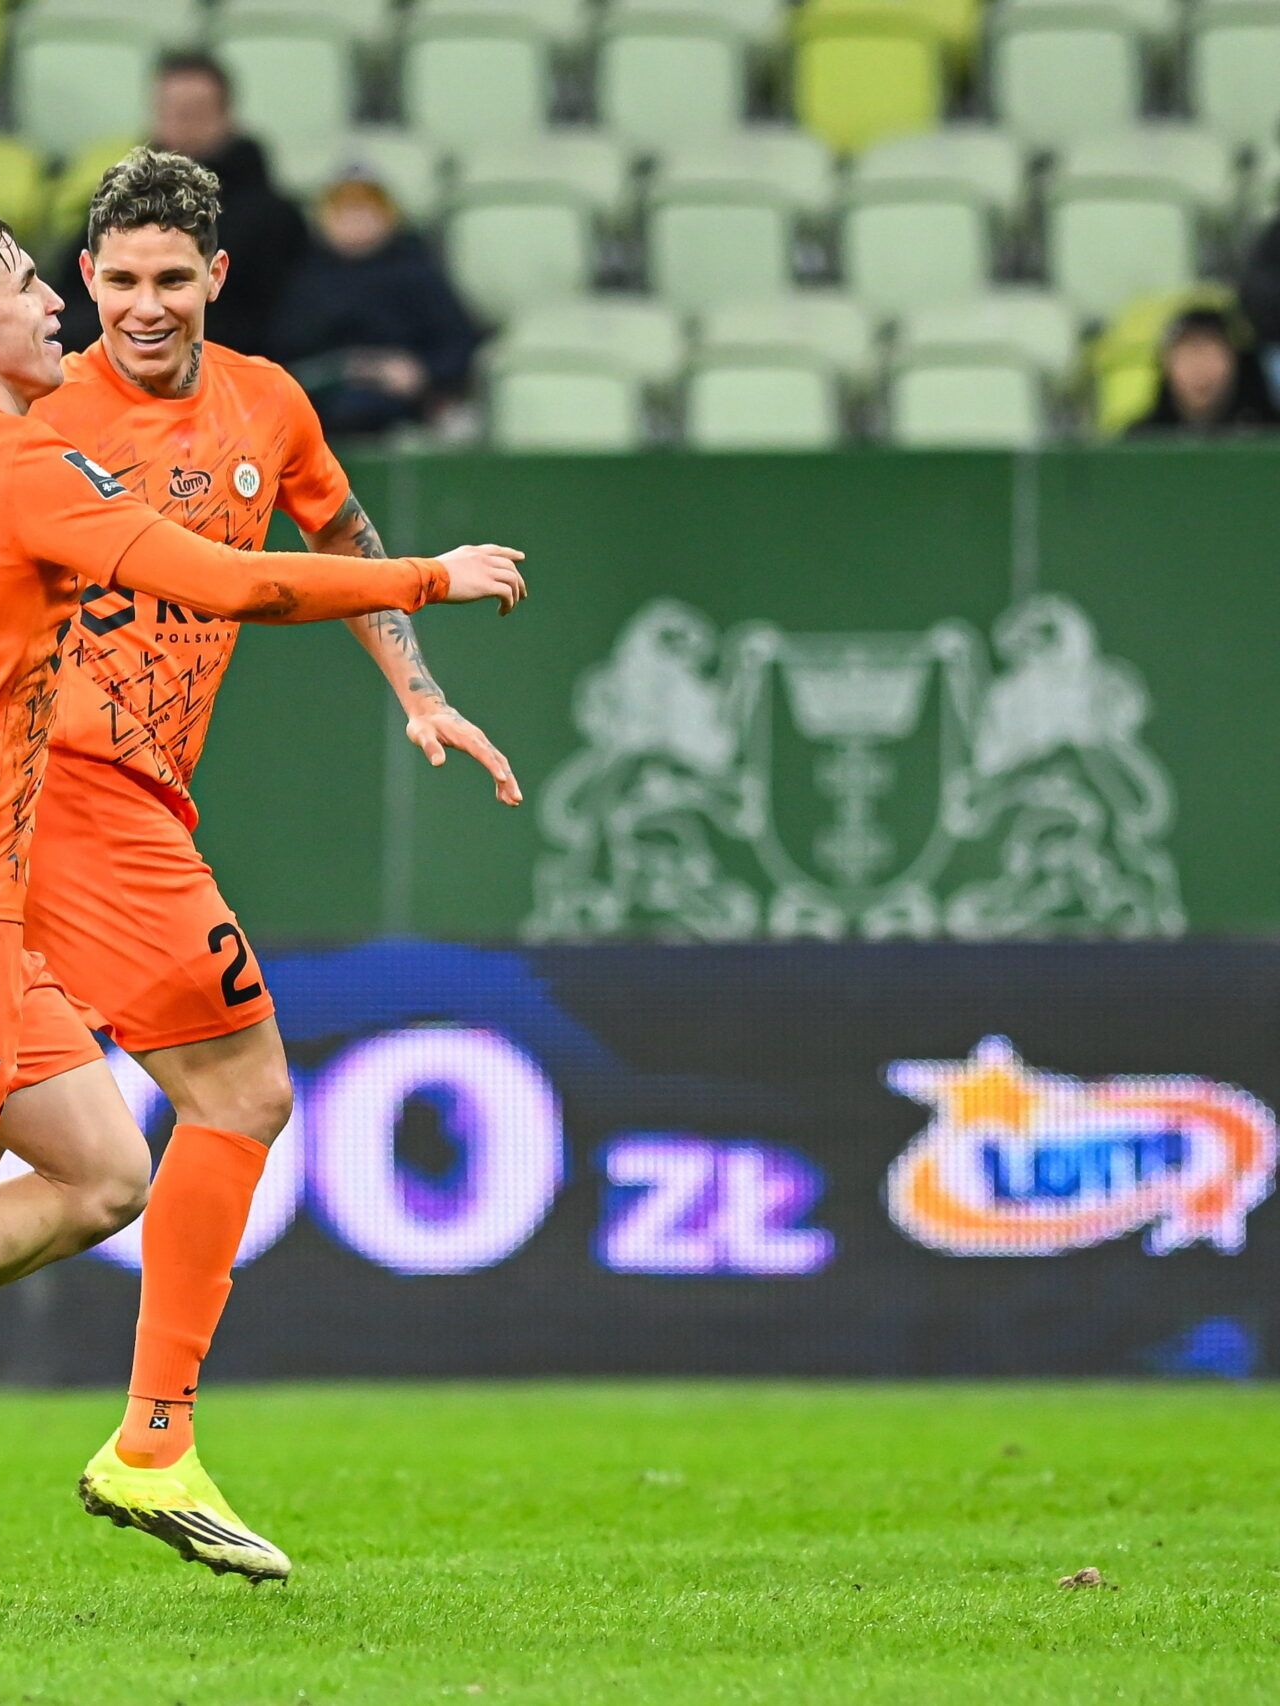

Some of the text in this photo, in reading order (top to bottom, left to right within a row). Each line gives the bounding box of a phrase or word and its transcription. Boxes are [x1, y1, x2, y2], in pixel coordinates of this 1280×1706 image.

[176, 476, 203, 493] LOTTO
[155, 632, 221, 644] POLSKA
[152, 711, 170, 730] 946
[207, 922, 262, 1007] 2
